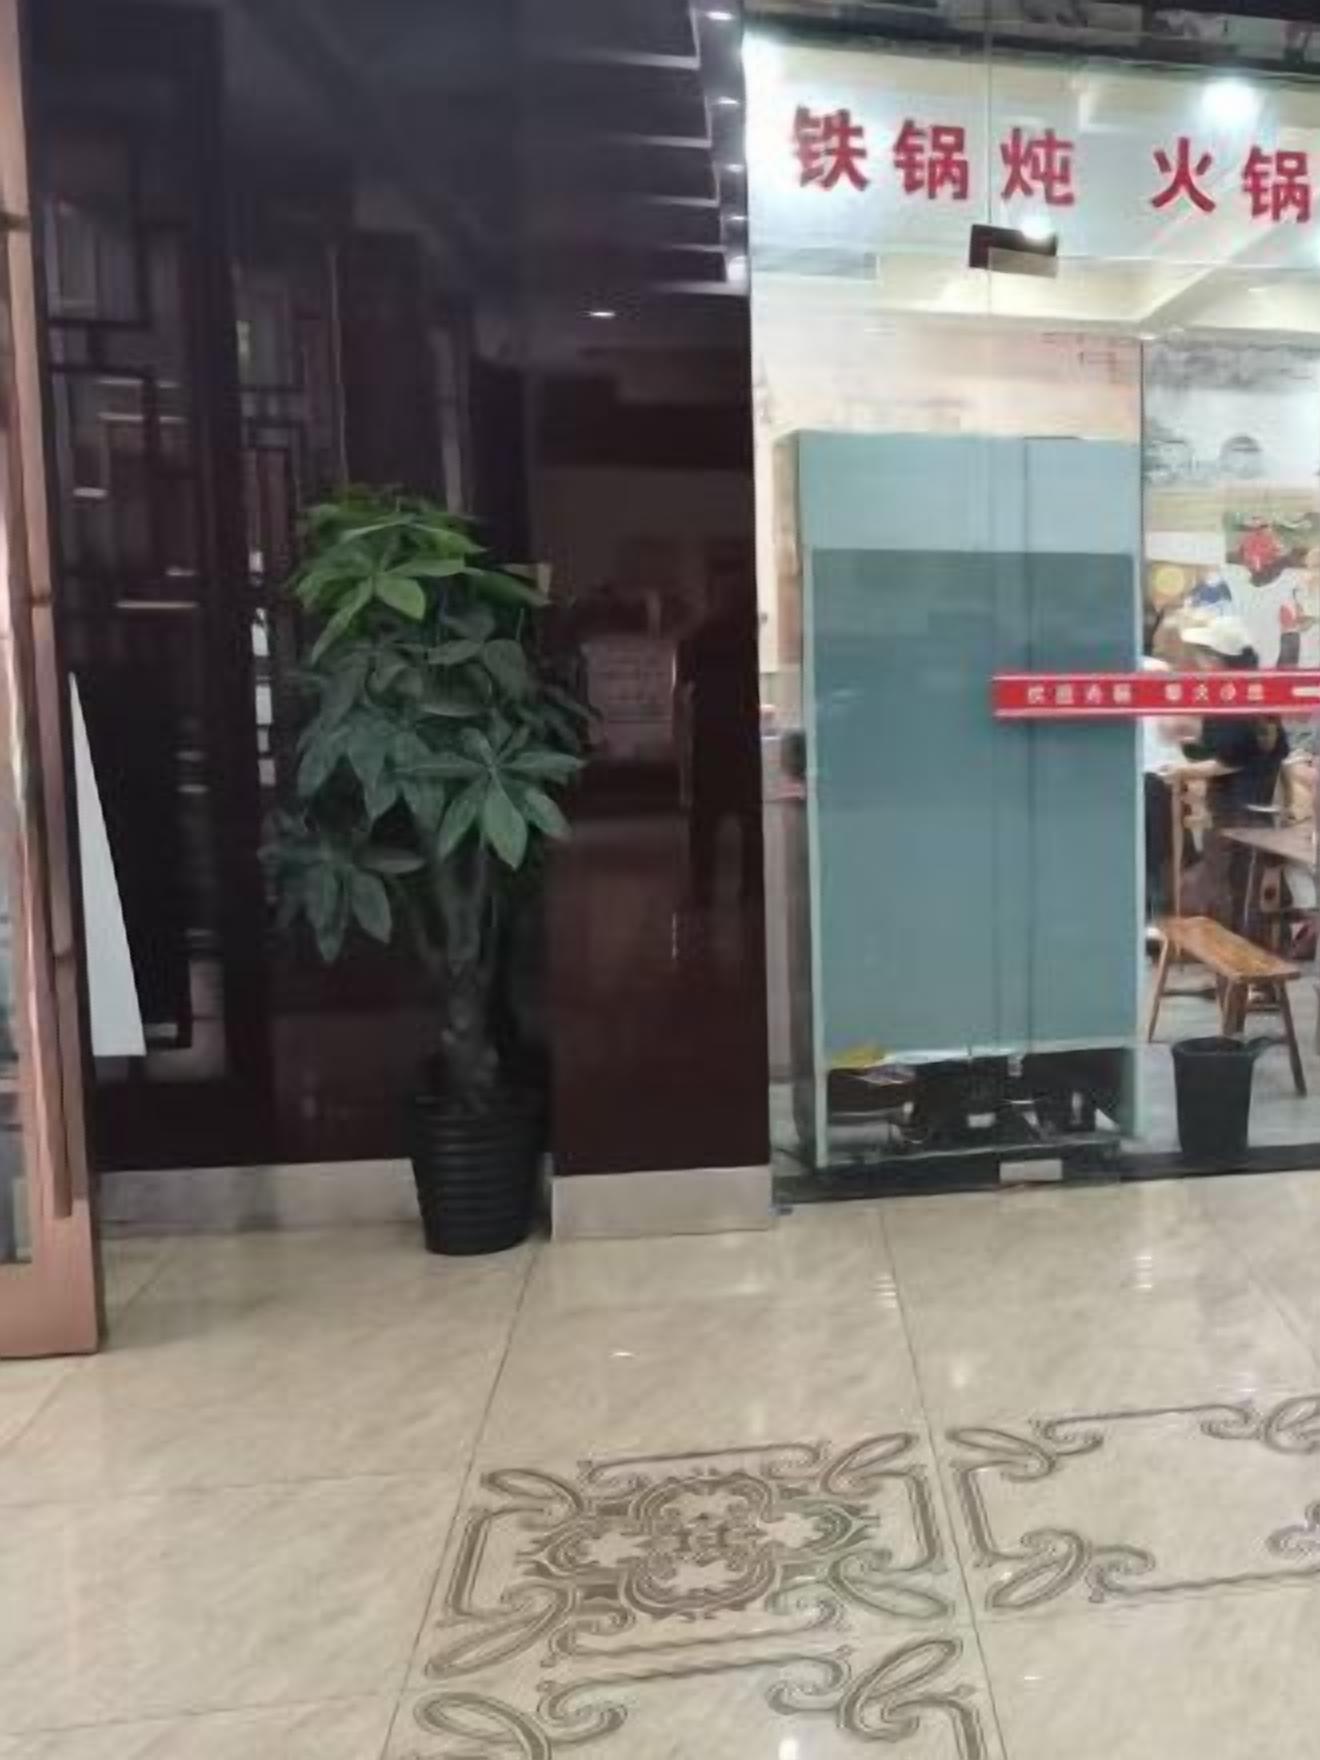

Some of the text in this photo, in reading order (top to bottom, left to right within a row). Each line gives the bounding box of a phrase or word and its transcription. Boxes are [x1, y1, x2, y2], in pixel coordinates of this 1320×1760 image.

[792, 106, 1075, 206] 铁锅炖
[1151, 137, 1313, 224] 火锅
